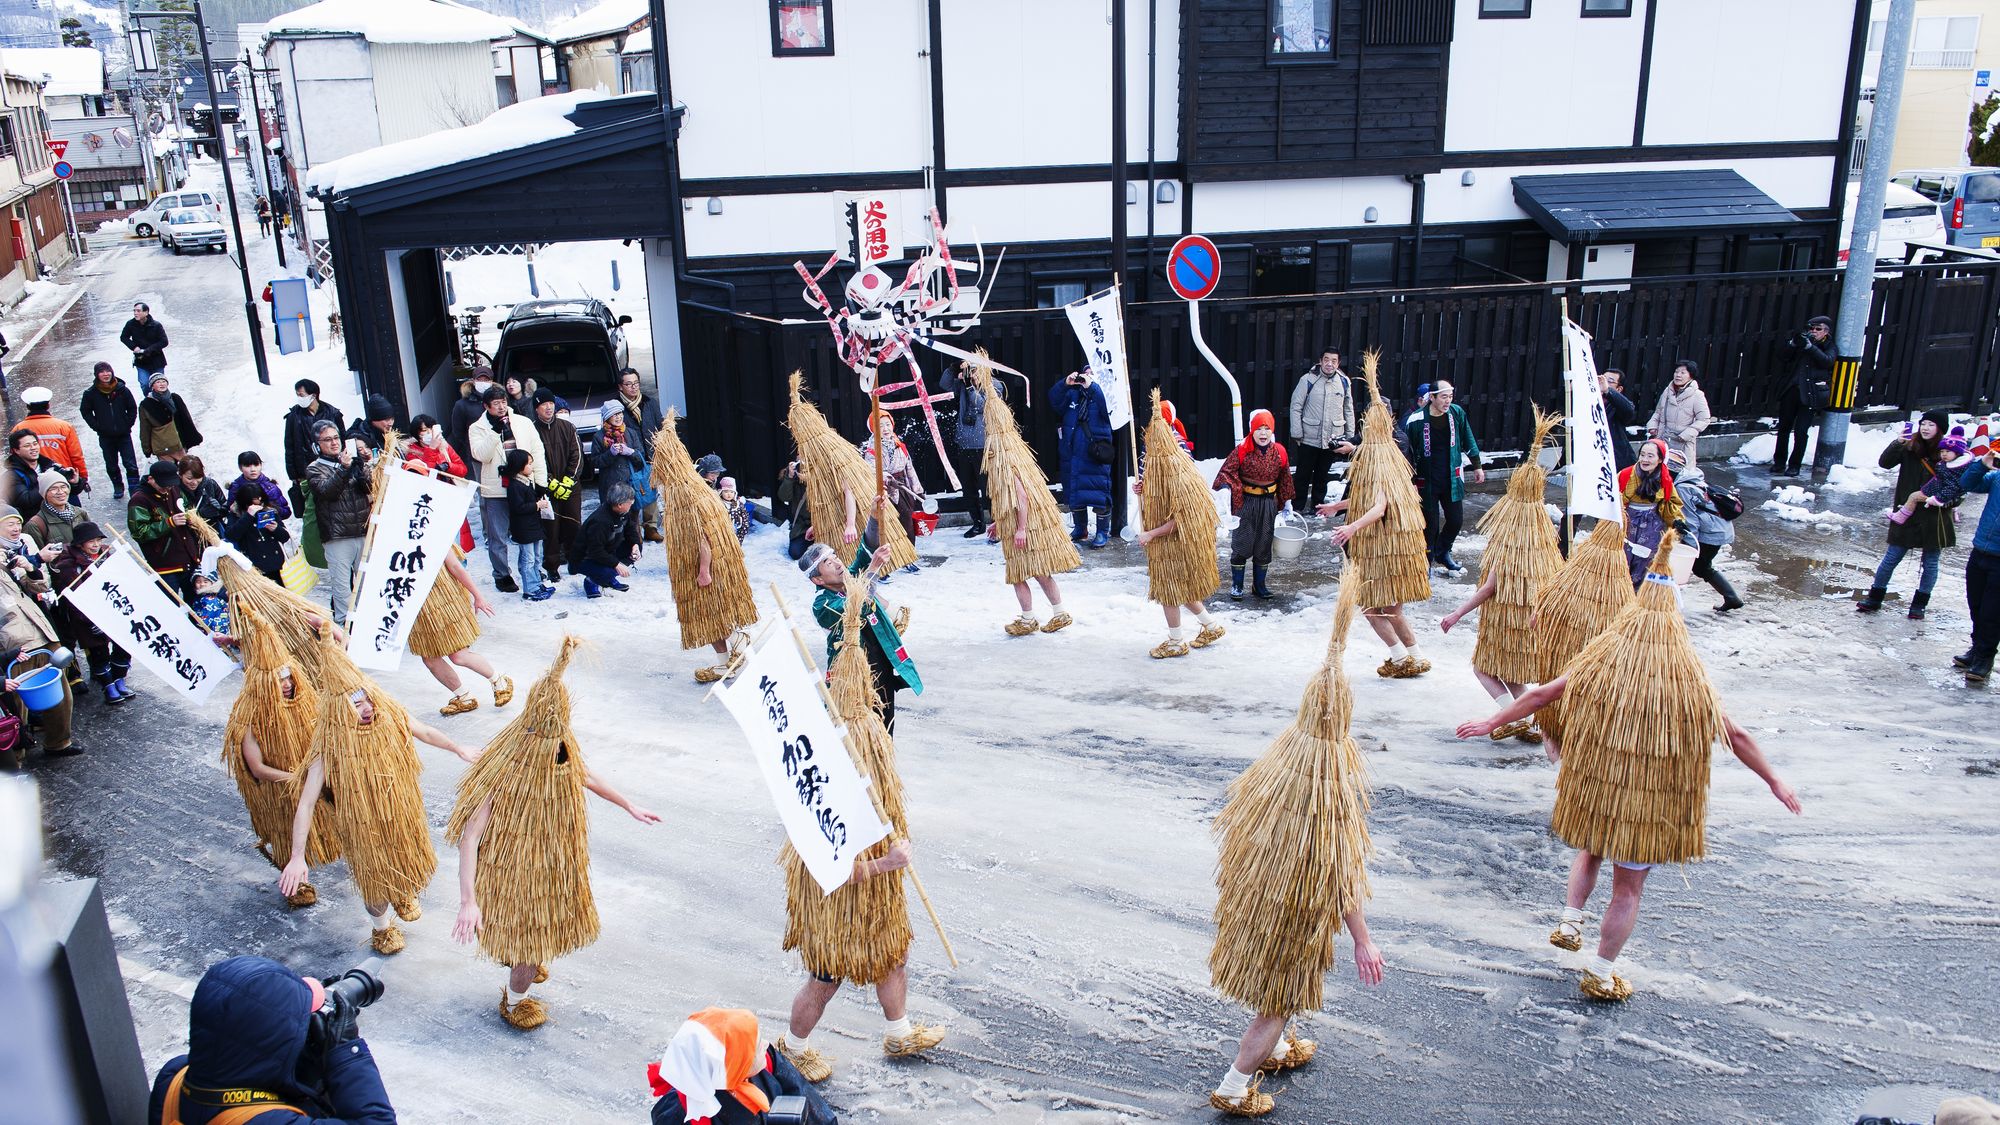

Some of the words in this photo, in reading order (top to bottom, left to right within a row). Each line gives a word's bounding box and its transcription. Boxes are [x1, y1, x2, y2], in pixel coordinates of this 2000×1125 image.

[863, 200, 889, 262] 火の用心
[223, 1090, 252, 1103] D600
